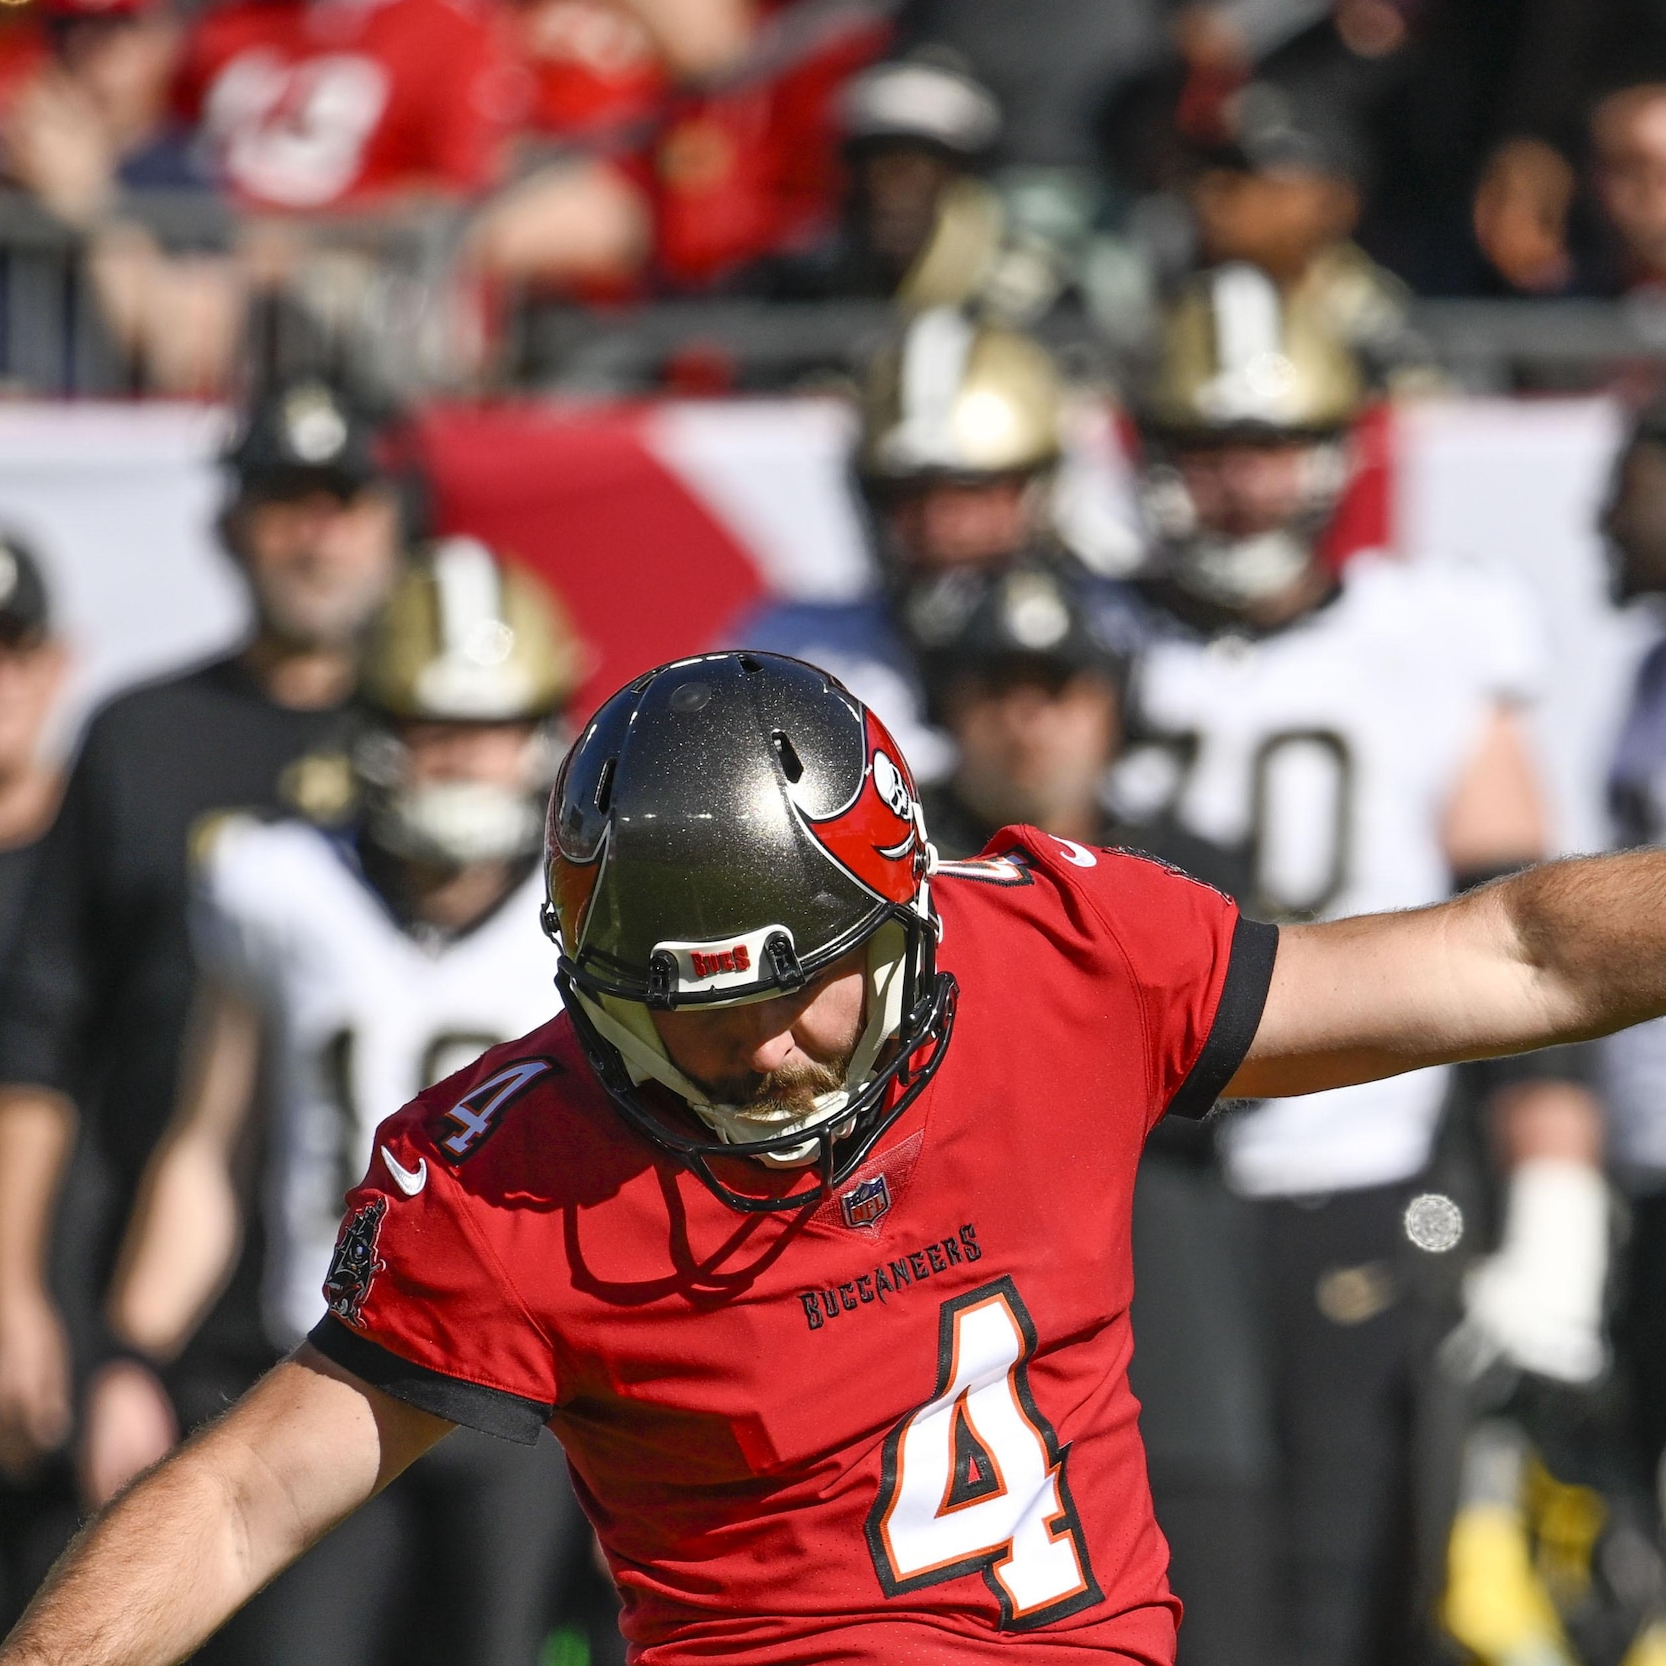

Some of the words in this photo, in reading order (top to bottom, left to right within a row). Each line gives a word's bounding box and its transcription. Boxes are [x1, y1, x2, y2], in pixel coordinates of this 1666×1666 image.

[689, 944, 751, 977] BUCS
[435, 1056, 560, 1165] 4
[851, 1196, 885, 1221] NFL
[797, 1223, 983, 1331] BUCCANEERS
[864, 1274, 1105, 1632] 4
